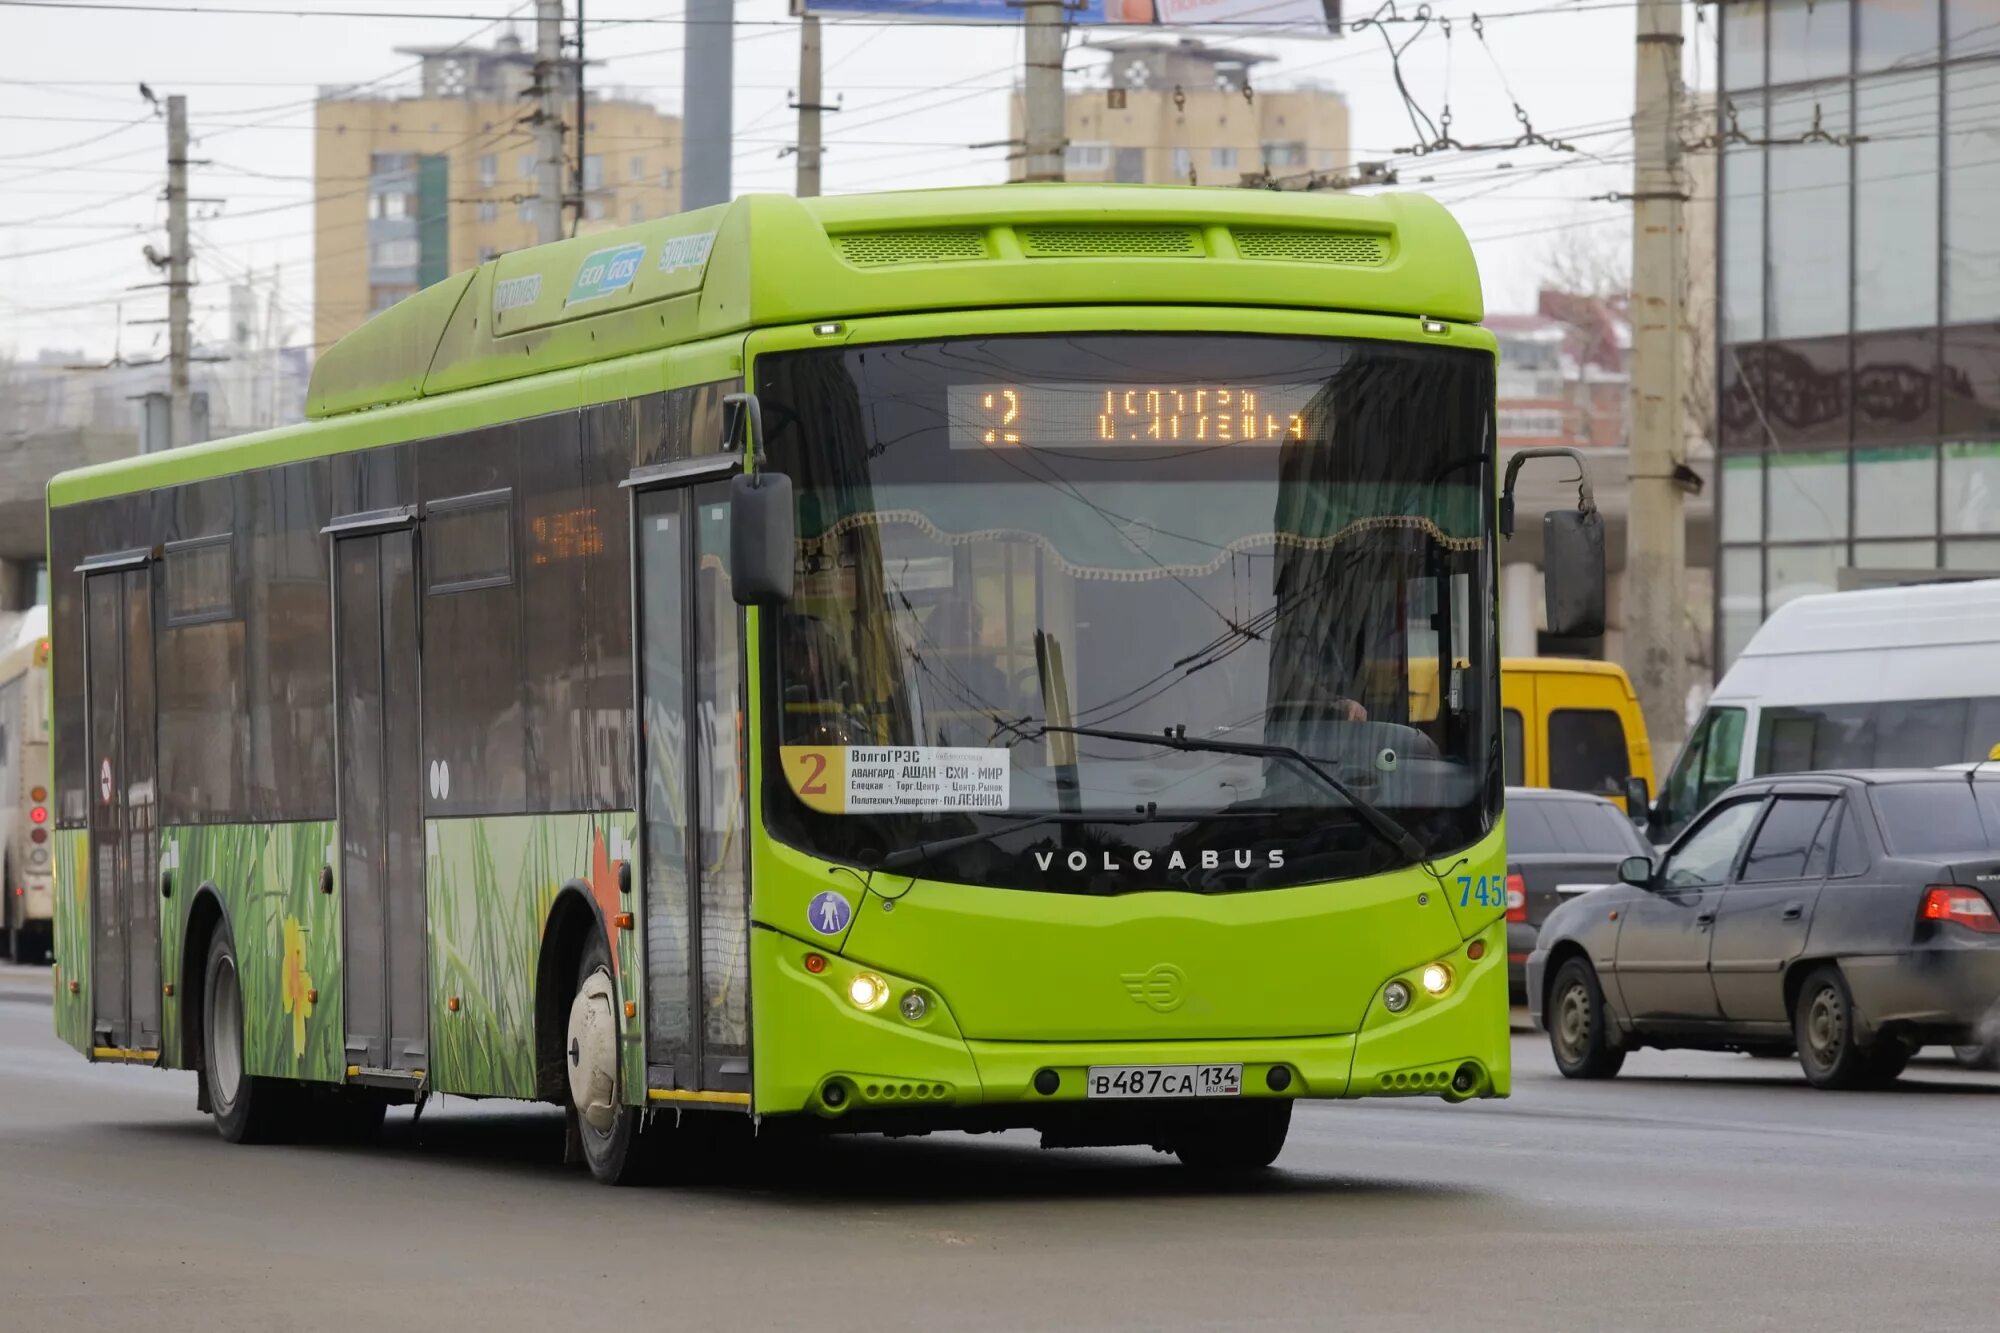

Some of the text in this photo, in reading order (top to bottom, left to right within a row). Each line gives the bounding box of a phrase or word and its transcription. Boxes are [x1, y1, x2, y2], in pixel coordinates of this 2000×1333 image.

[578, 264, 605, 287] ECO
[851, 750, 920, 763] ВолгоГРЭС
[799, 753, 827, 795] 2
[851, 766, 1003, 780] АВАНГАРД АШАН СХИ МИР
[851, 780, 884, 791] Елецкая
[1034, 849, 1285, 871] VOLGABUS
[1200, 1067, 1235, 1086] 134
[1205, 1085, 1224, 1093] RUS
